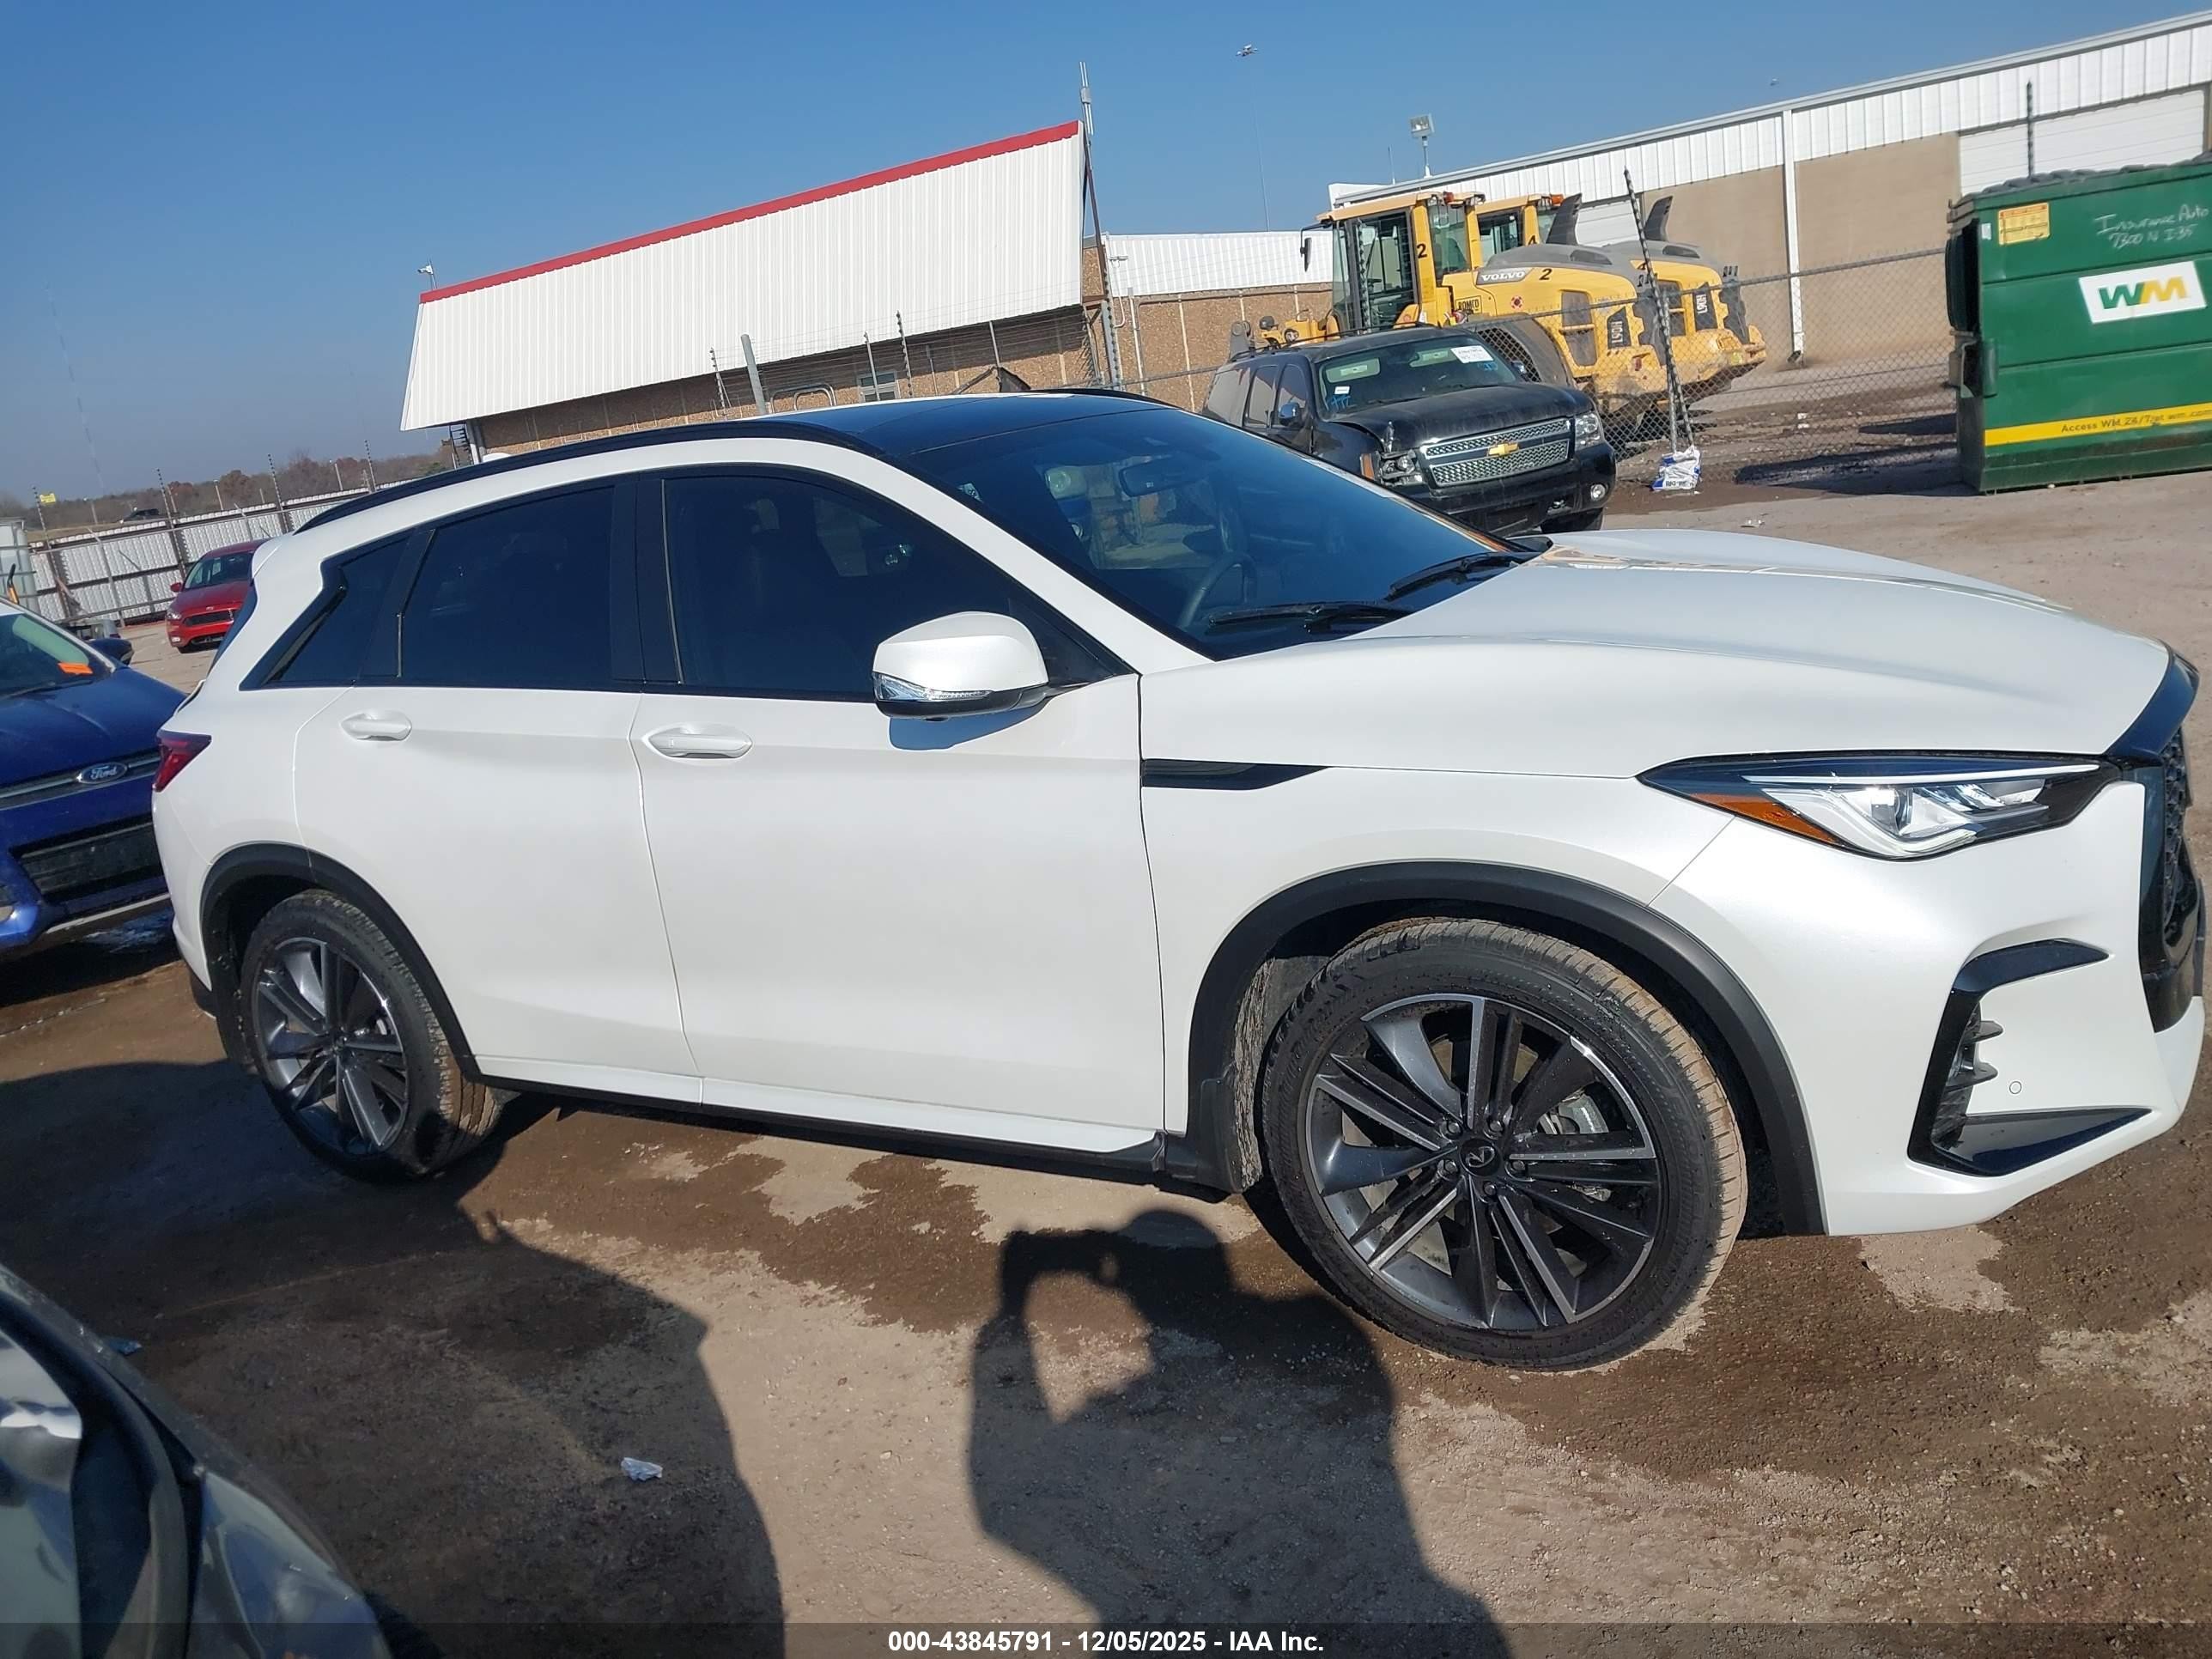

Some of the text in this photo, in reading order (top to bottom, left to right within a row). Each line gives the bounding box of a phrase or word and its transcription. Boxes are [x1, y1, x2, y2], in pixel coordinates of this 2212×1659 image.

[2179, 204, 2209, 222] Auto
[2148, 230, 2160, 241] N
[1417, 243, 1428, 258] 2
[1480, 270, 1526, 282] VOLVO
[1539, 268, 1553, 281] 2
[2098, 275, 2188, 310] WM
[1695, 294, 1708, 314] L90H
[1611, 321, 1624, 343] L90H
[2061, 423, 2098, 434] Access
[2124, 414, 2151, 427] 24/7
[90, 765, 118, 781] Ford
